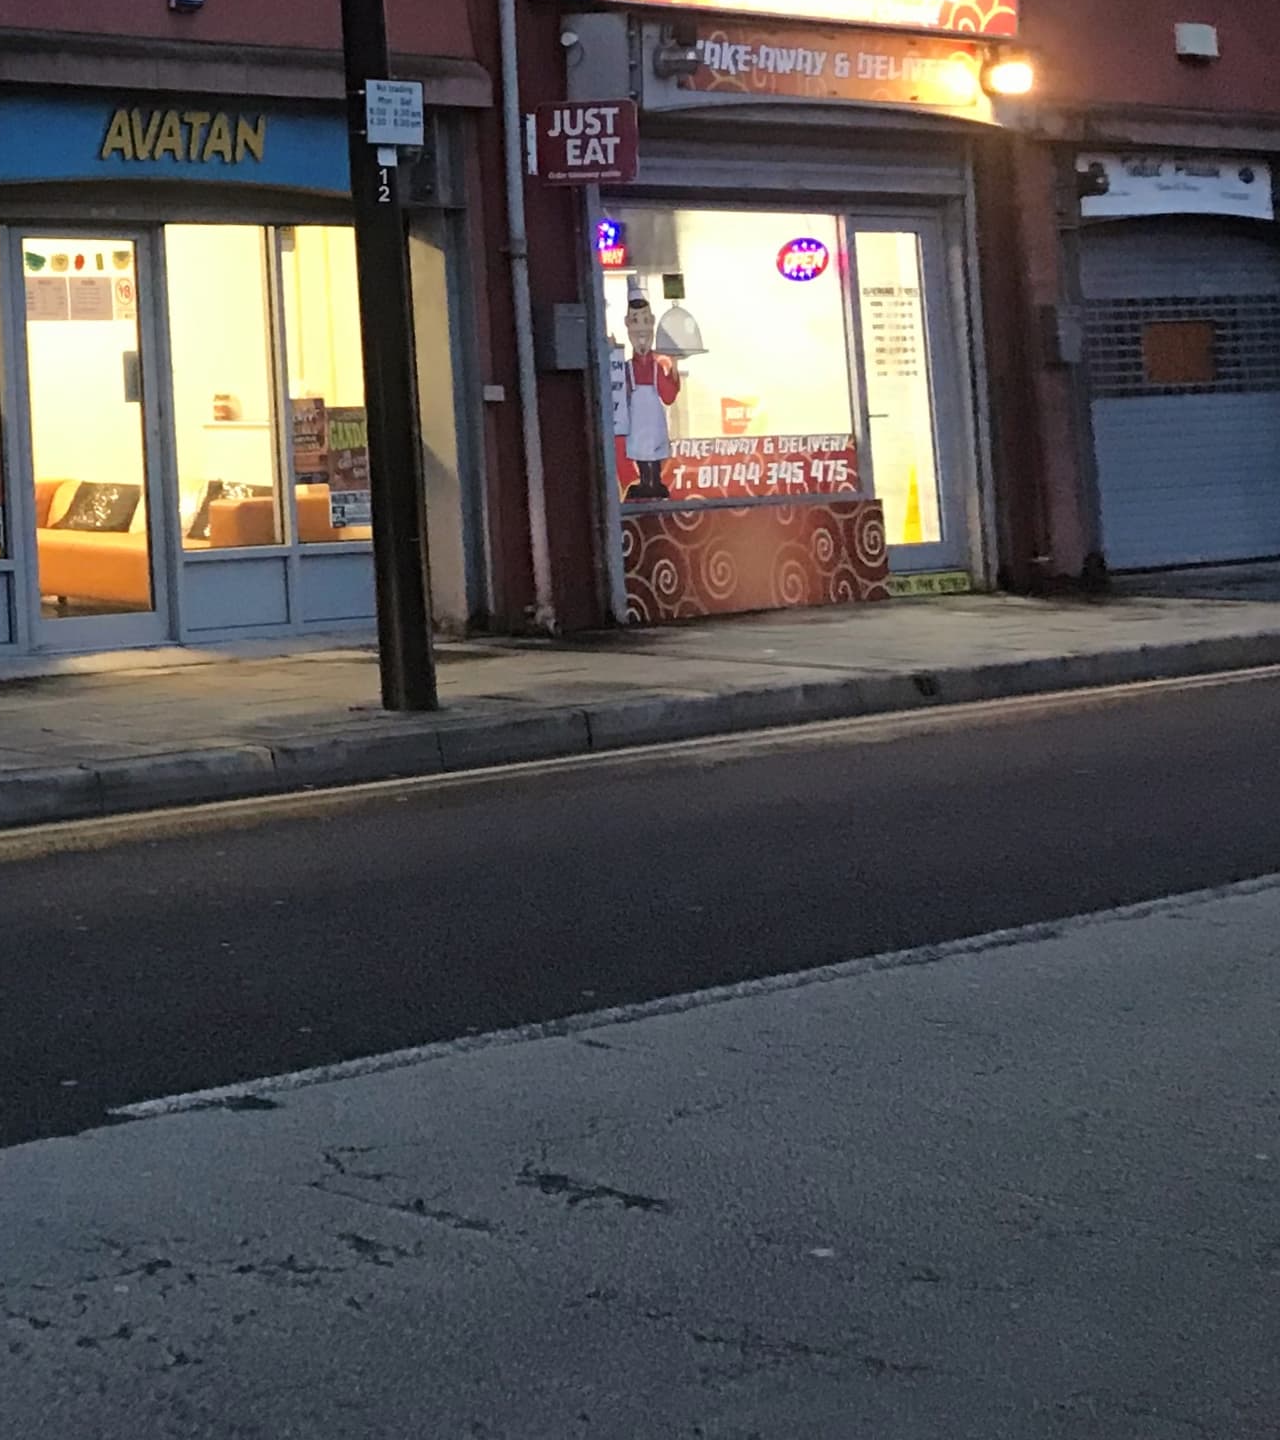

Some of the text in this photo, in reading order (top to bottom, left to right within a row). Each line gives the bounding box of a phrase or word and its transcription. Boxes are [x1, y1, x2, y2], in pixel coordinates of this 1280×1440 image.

[834, 52, 849, 79] &
[102, 107, 267, 164] AVATAN
[547, 107, 619, 137] JUST
[566, 137, 621, 166] EAT
[784, 248, 825, 268] OPEN
[763, 437, 774, 455] &
[778, 435, 849, 455] DELIVERY
[697, 462, 760, 489] 01744
[767, 461, 804, 485] 345
[810, 459, 848, 483] 475
